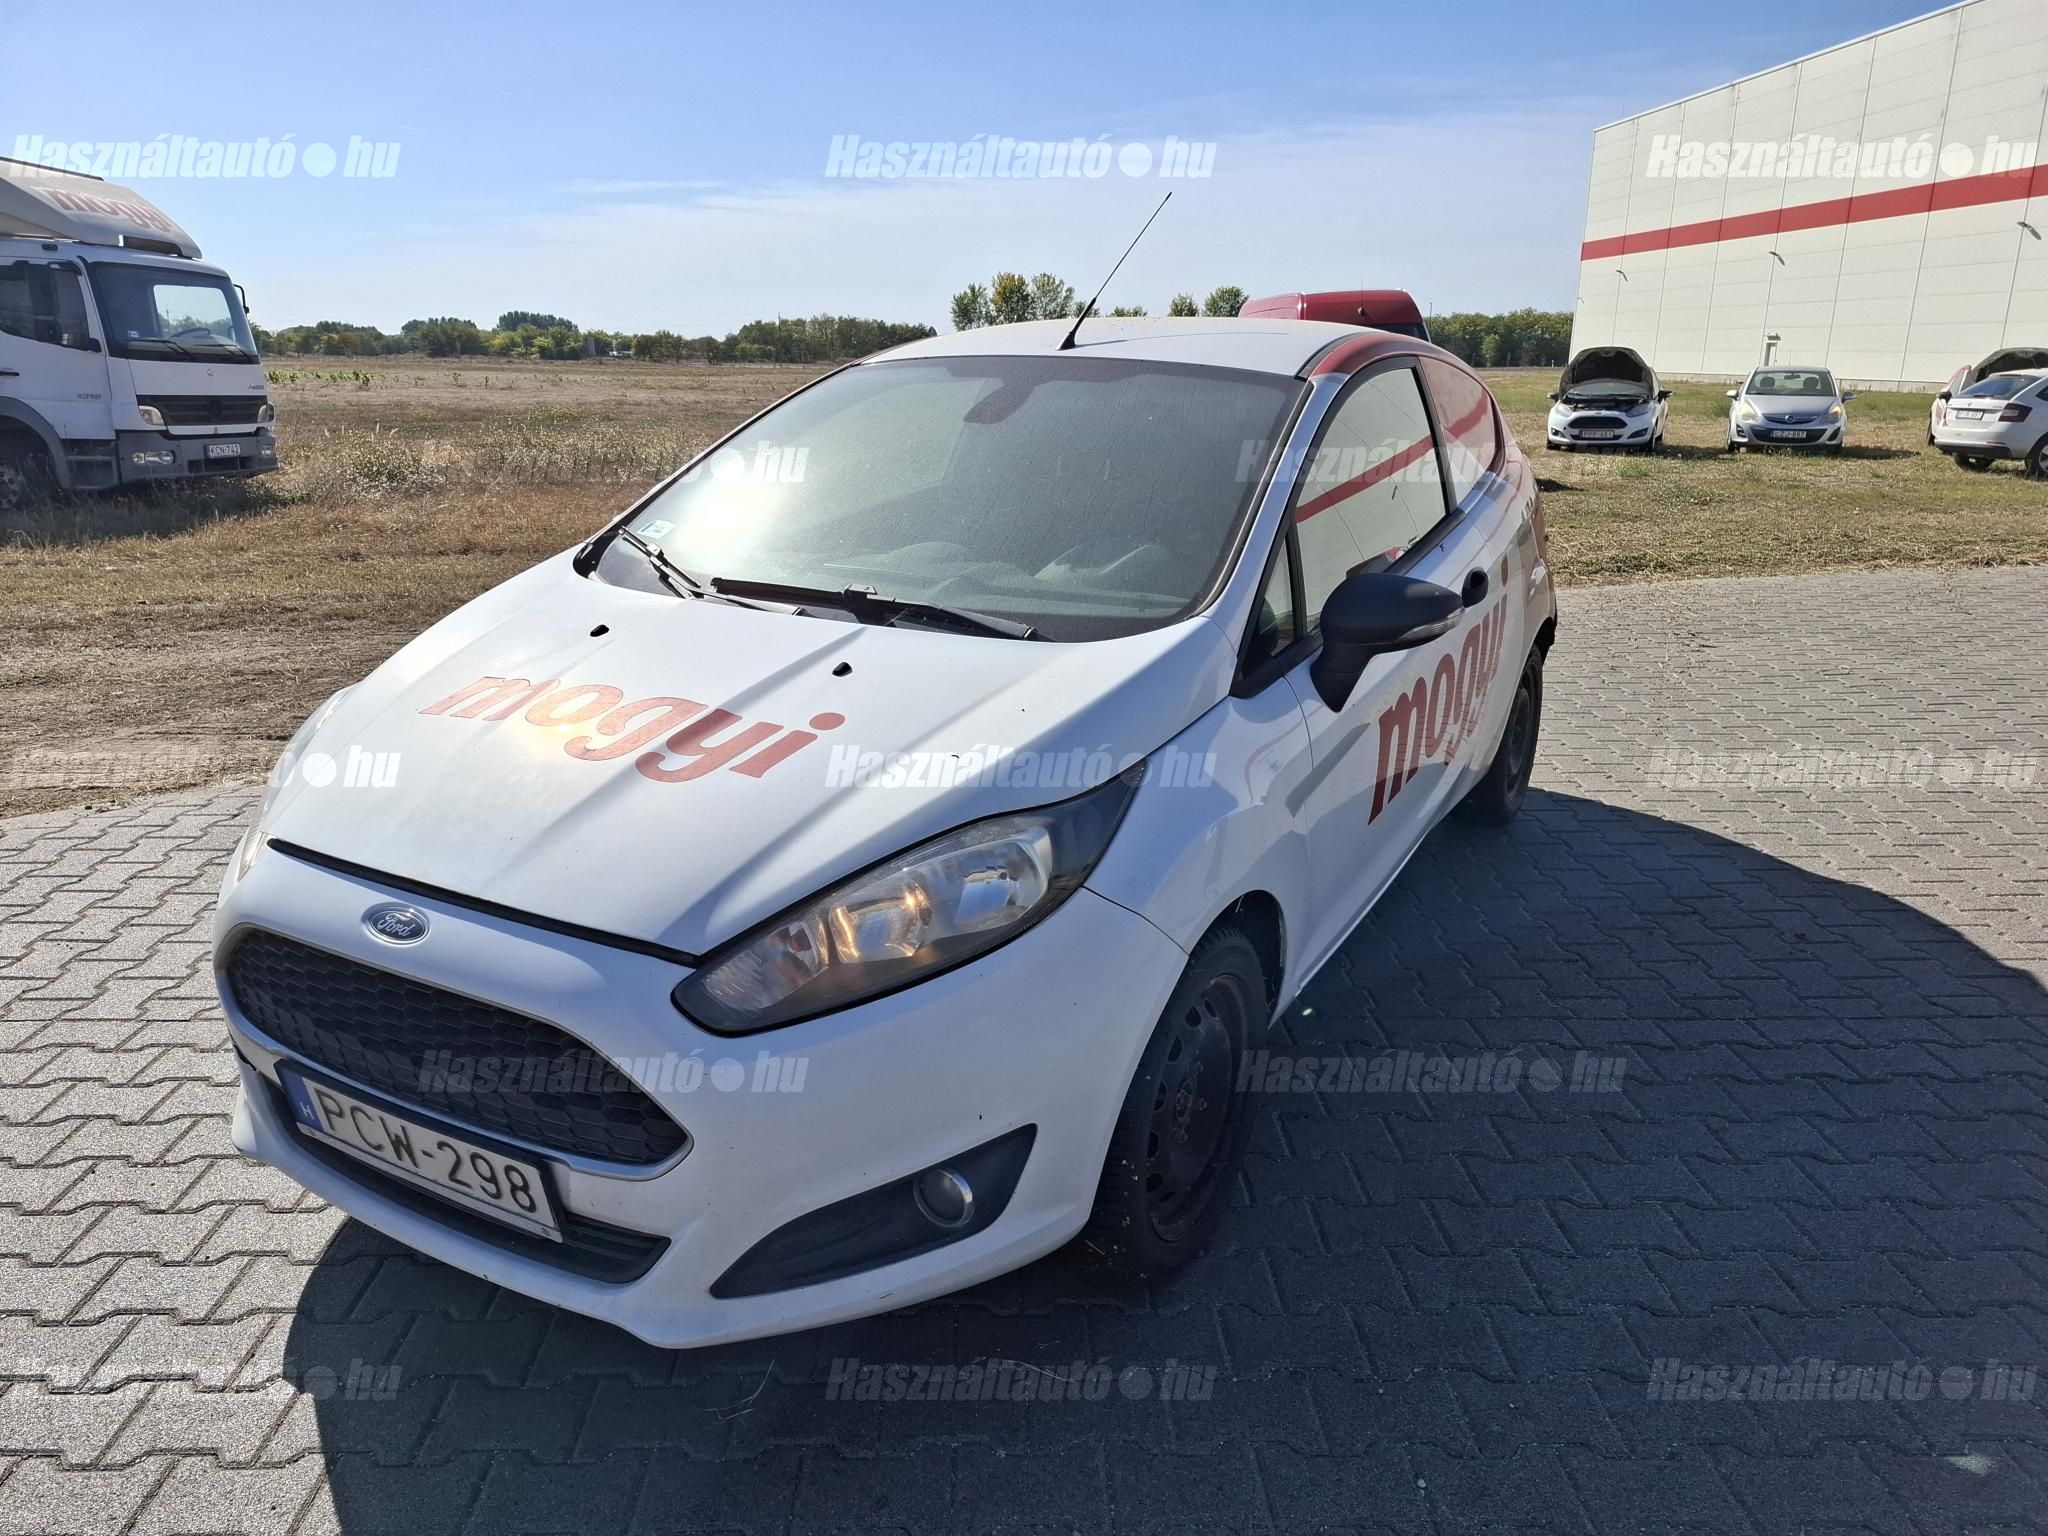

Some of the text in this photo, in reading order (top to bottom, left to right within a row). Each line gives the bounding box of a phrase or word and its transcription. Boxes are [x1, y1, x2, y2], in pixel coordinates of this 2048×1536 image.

[419, 675, 846, 784] mogyi
[377, 913, 416, 937] Ford
[313, 1089, 537, 1213] PCW-298
